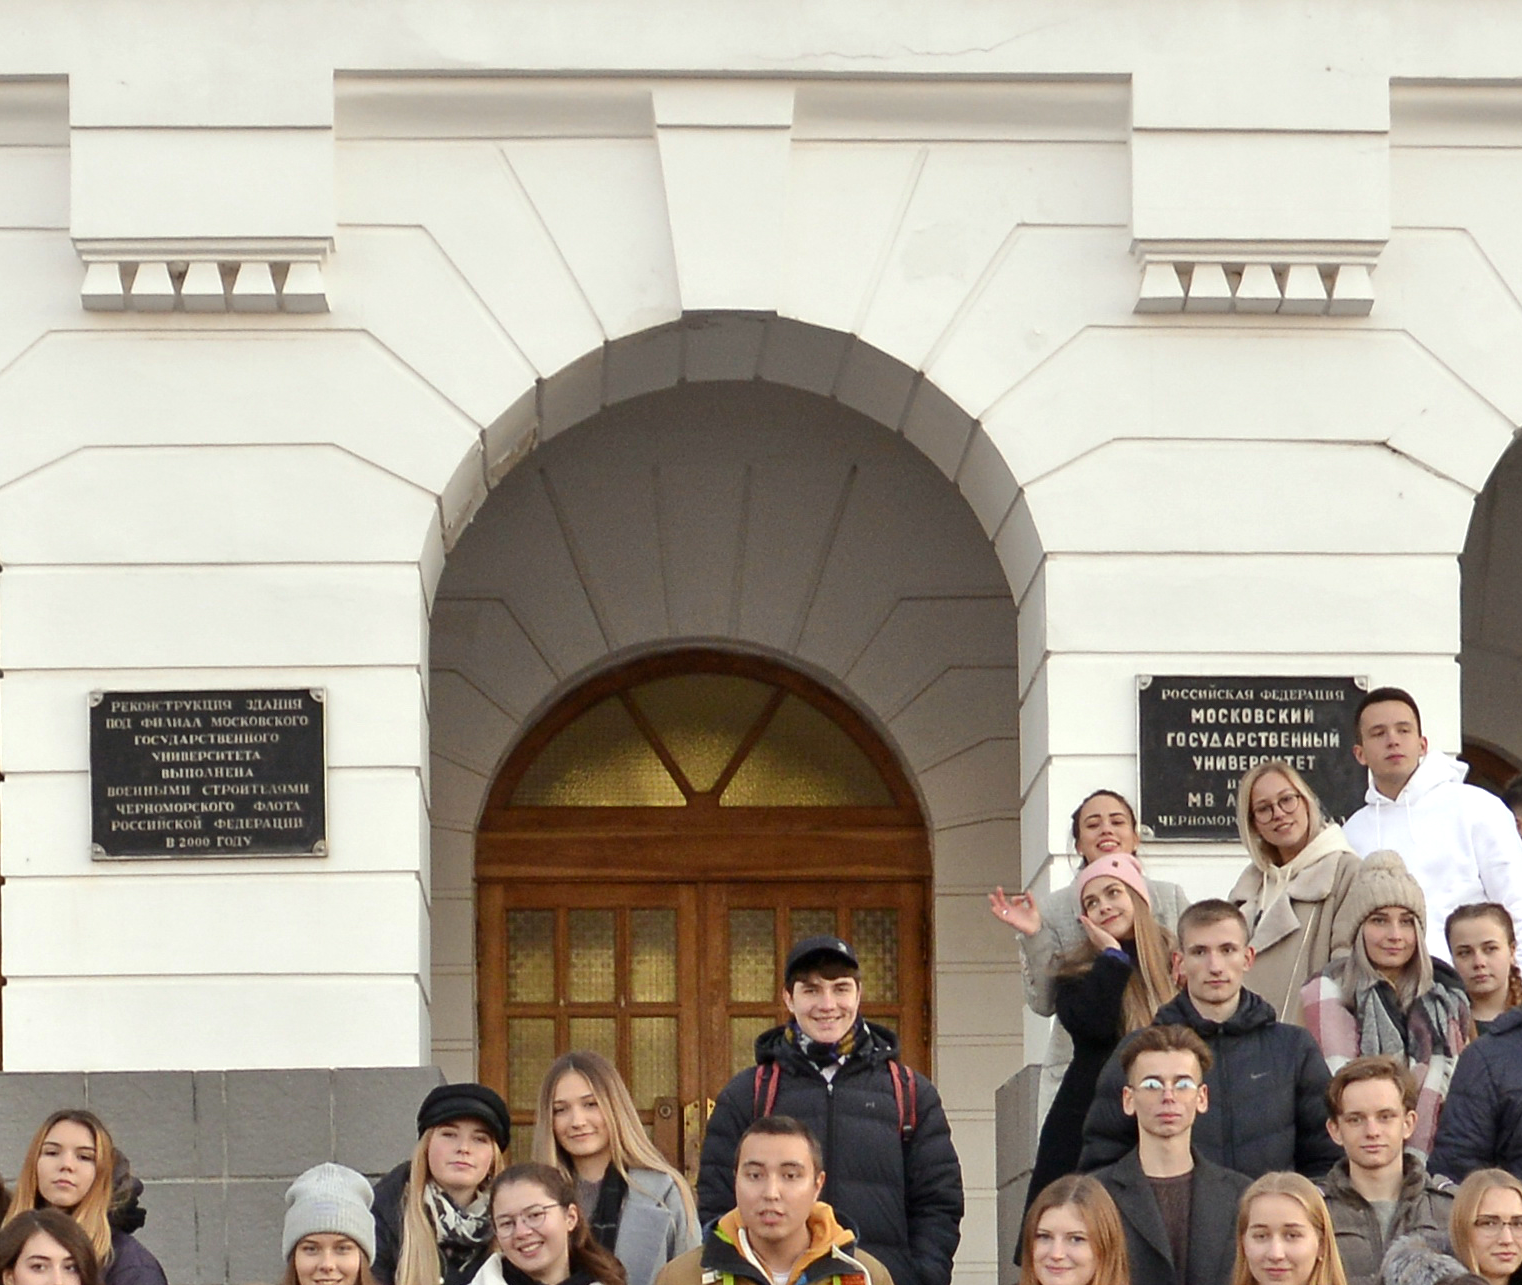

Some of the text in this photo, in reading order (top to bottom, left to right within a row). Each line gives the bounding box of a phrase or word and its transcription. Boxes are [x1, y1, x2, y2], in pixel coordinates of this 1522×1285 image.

[1161, 684, 1345, 701] РОССИЙСКАЯ ФЕДЕРАЦИЯ
[111, 699, 302, 713] РЕКОНСТРУКЦИЯ ЗДАНИЯ
[1191, 704, 1314, 724] МОСКОВСКИЙ
[106, 715, 308, 729] ПОД ФИЛИАЛ МОСКОВСКОГО
[134, 733, 279, 745] ГОСУДАРСТВЕННОГО
[1166, 728, 1340, 748] ГОСУДАРСТВЕННЫЙ
[152, 751, 261, 762] УНИВЕРСИТЕТА
[162, 768, 254, 779] ВЫПОЛНЕНА
[107, 784, 309, 797] ВОЕННЫМИ СТРОИТЕЛЯМИ
[116, 801, 300, 815] ЧЕРНОМОРСКОГО ФЛОТА
[111, 816, 303, 831] РОССИЙСКОЙ ФЕДЕРАЦИИ
[1158, 815, 1238, 827] ЧЕРНОМОР
[166, 836, 252, 848] В 2000 ГОДУ
